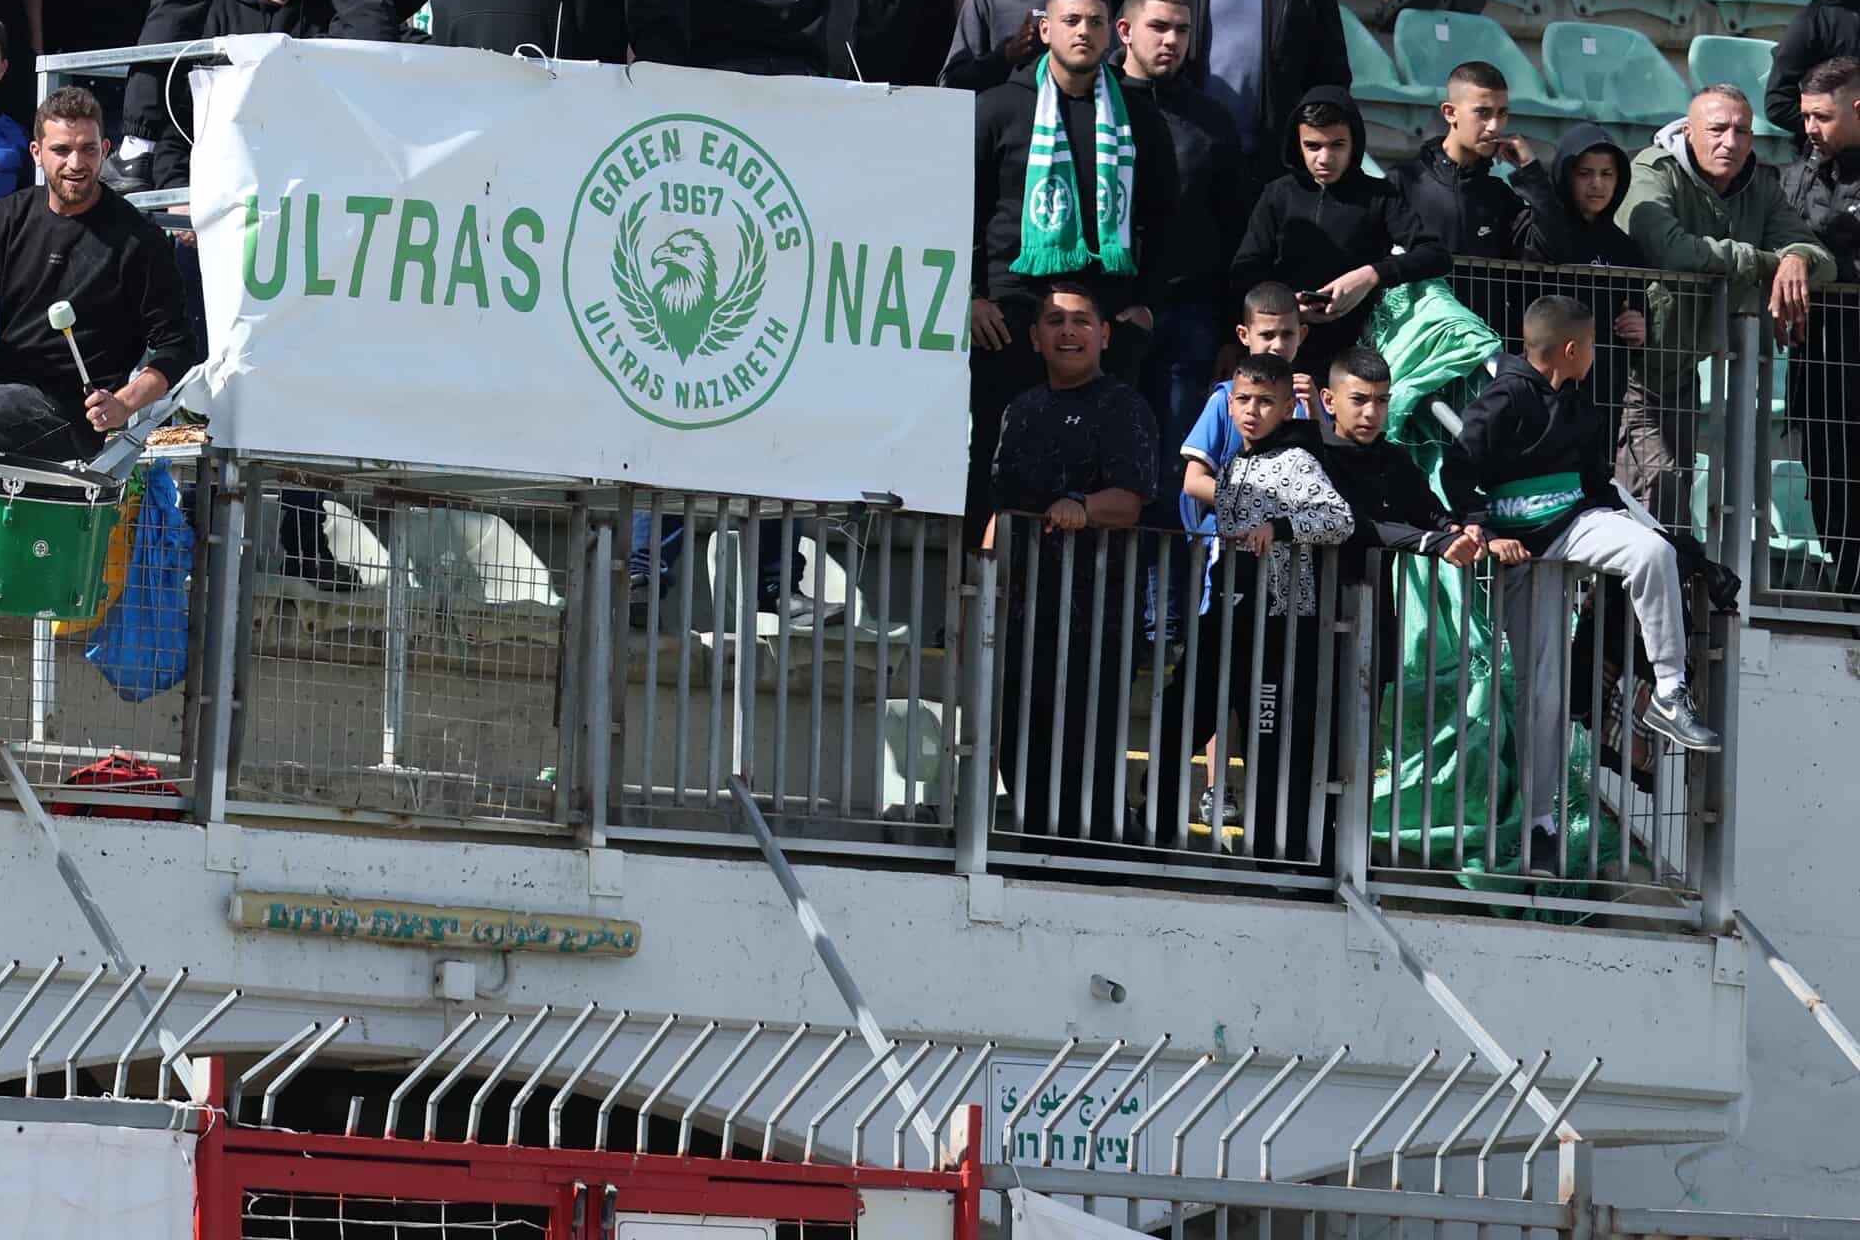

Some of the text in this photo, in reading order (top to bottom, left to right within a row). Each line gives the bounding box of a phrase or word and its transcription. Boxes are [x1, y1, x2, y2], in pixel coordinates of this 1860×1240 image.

[589, 128, 801, 251] GREEN EAGLES
[659, 181, 724, 216] 1967
[242, 193, 545, 312] ULTRAS
[584, 301, 789, 409] ULTRAS NAZARETH
[1002, 1131, 1064, 1161] חרו
